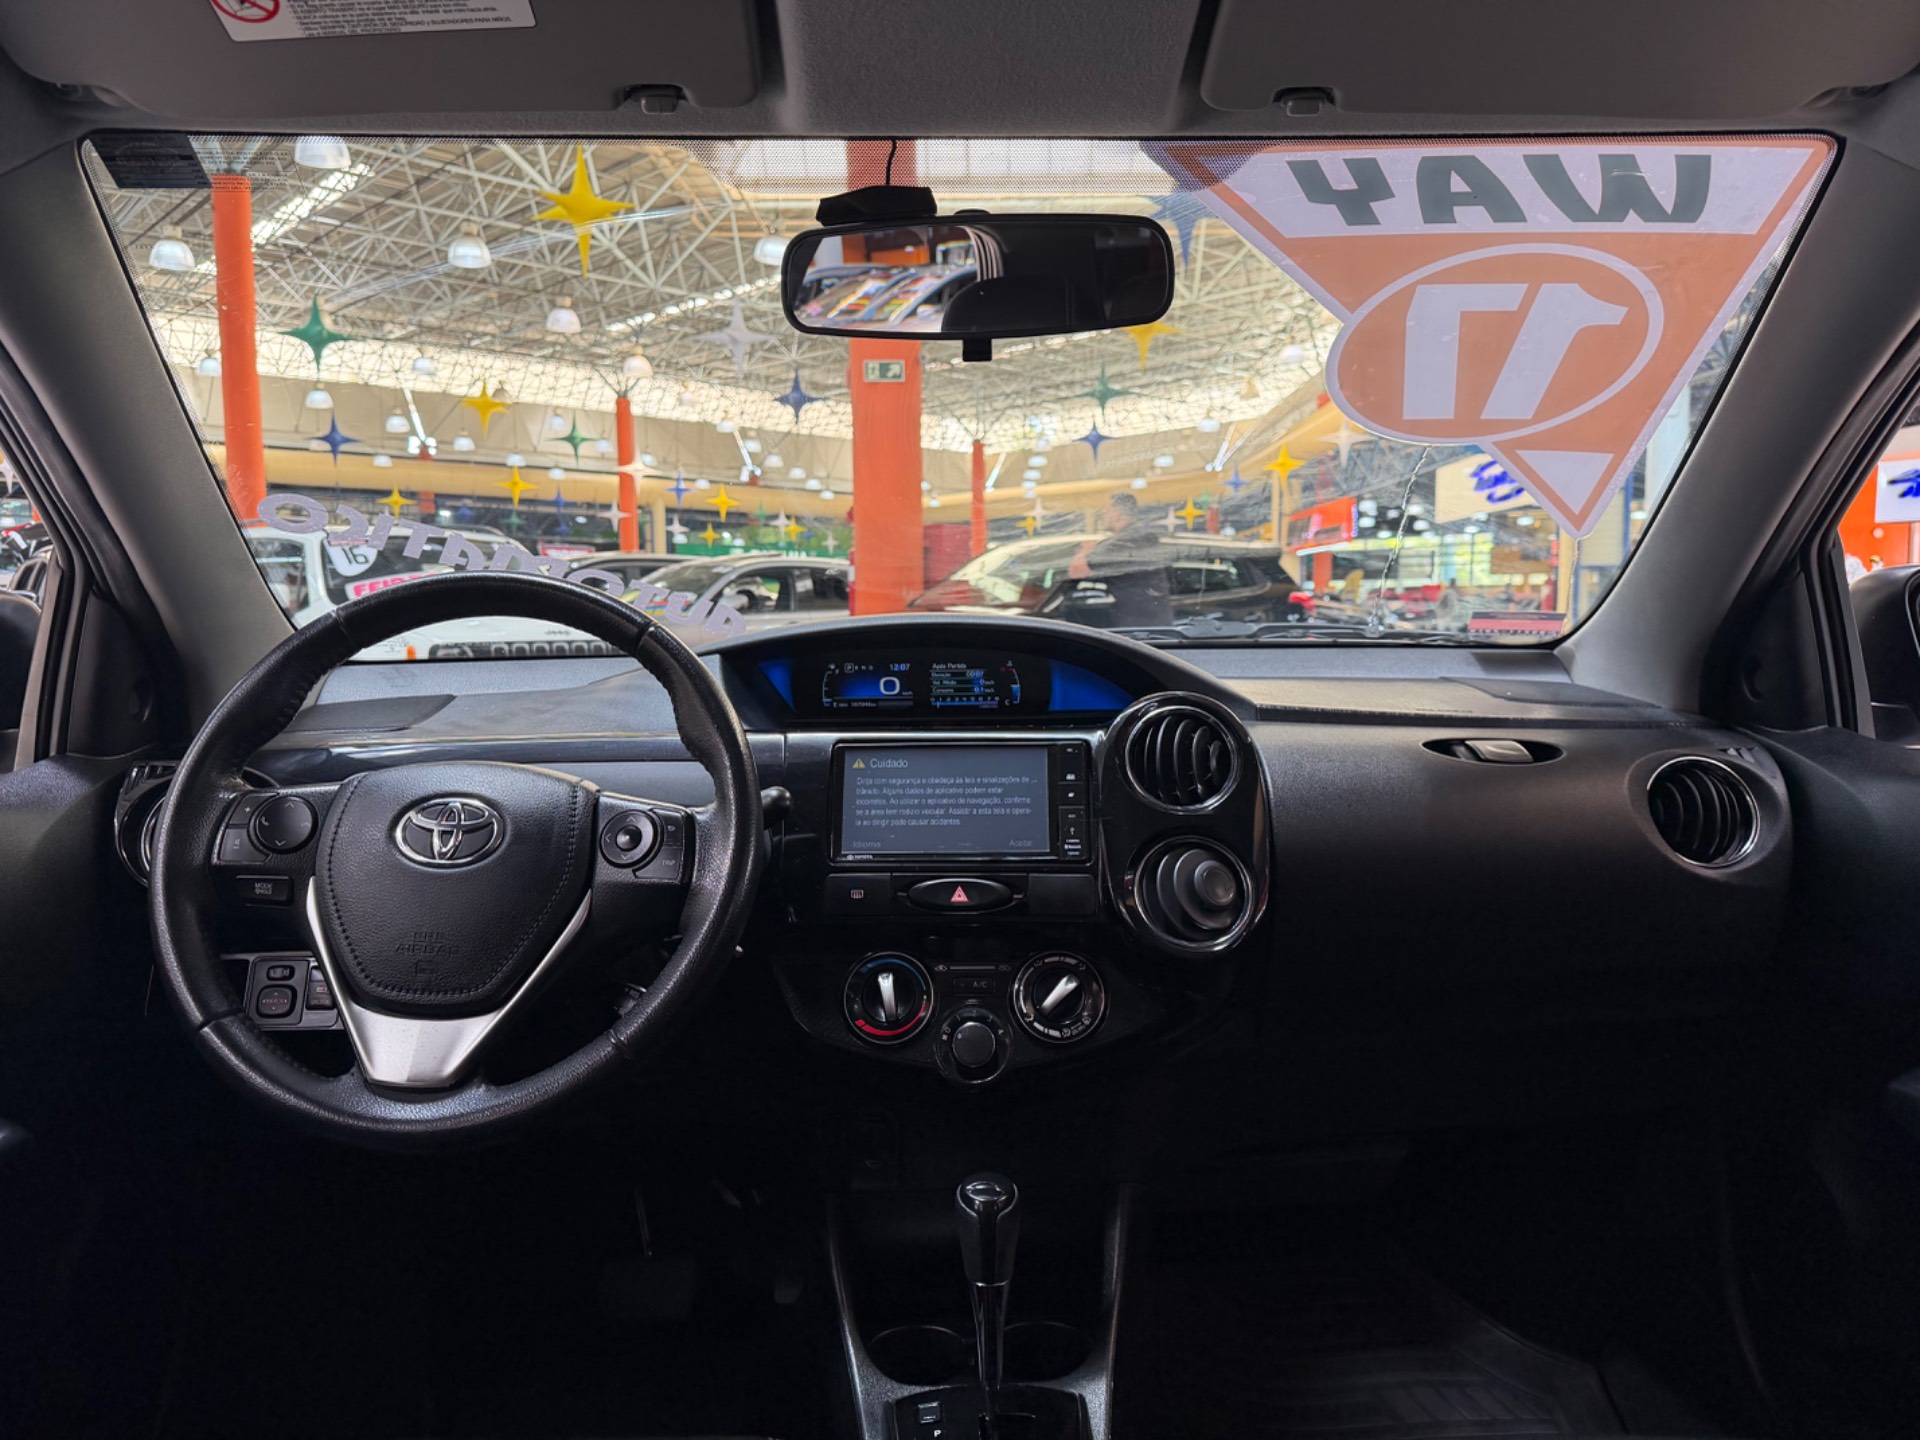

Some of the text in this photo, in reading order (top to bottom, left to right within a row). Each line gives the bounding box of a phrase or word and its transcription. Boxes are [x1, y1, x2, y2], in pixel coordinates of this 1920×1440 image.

[879, 676, 901, 695] 0
[869, 758, 909, 769] Cuidado
[853, 840, 881, 849] Idioma
[972, 980, 988, 989] A/C
[933, 1430, 942, 1438] P
